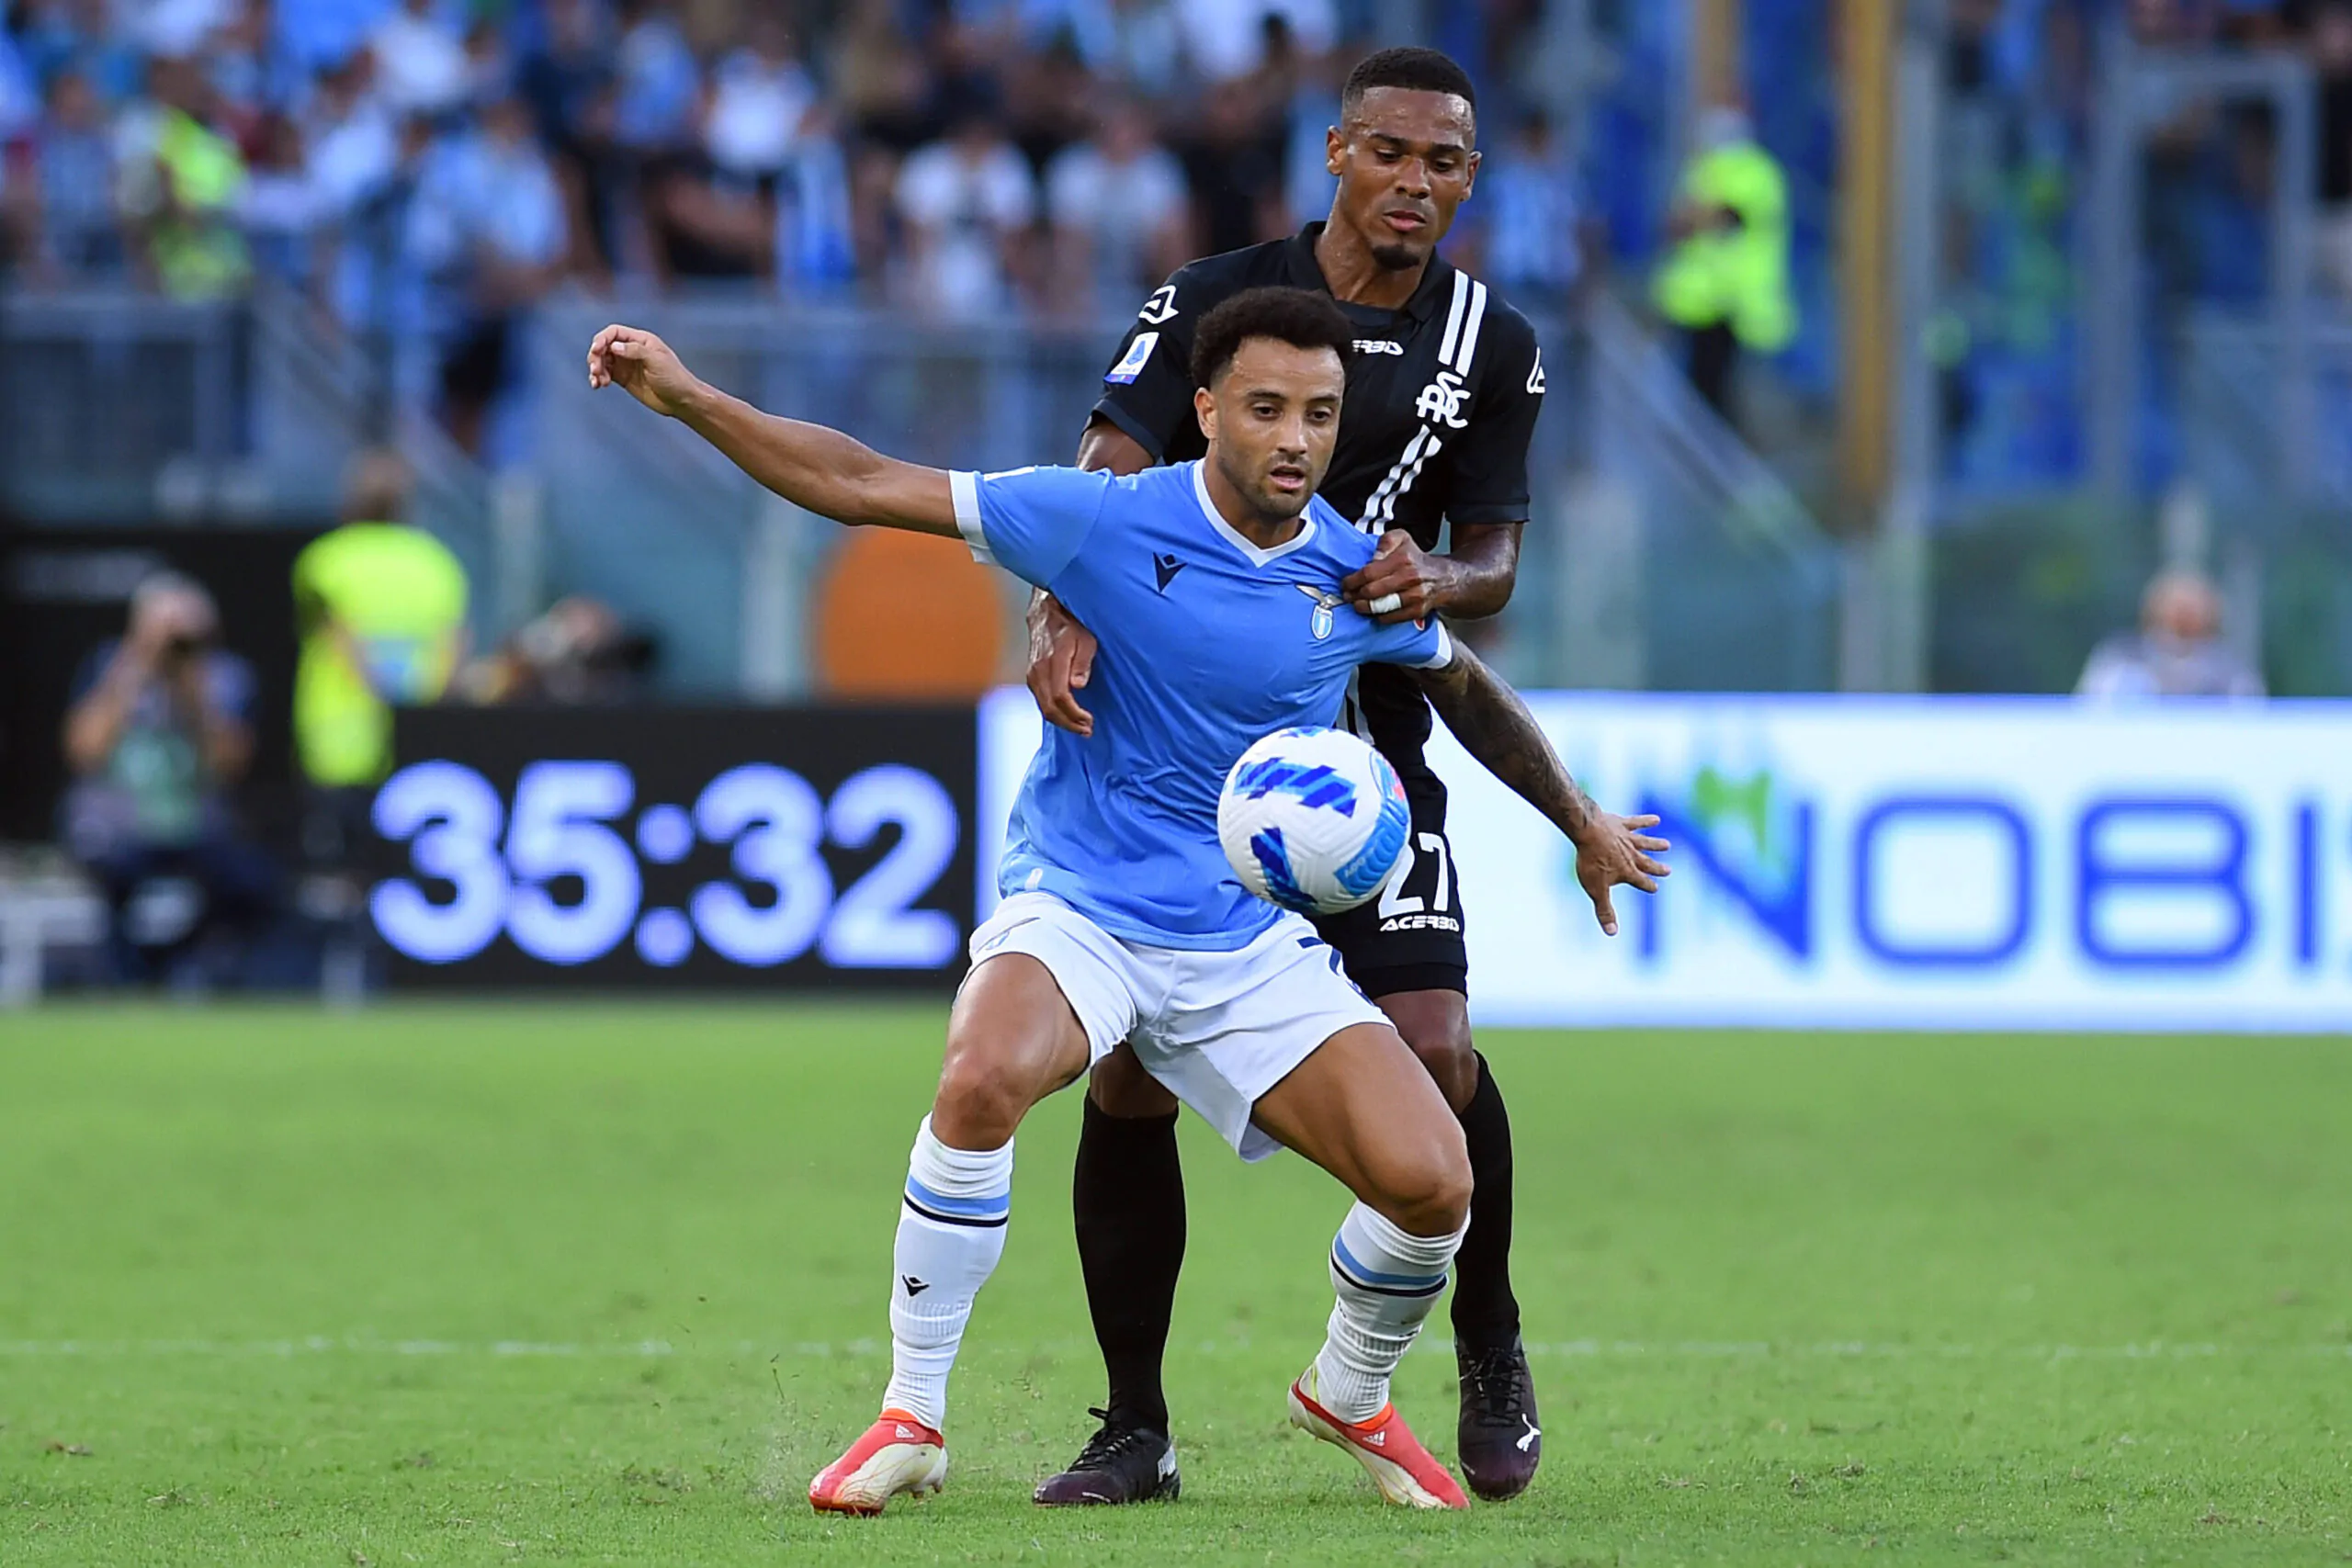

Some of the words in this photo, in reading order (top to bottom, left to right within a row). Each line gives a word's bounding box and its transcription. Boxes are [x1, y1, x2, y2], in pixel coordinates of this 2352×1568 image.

[370, 759, 960, 968] 35:32
[1378, 831, 1449, 919] 27
[1637, 788, 2352, 969] NOBI
